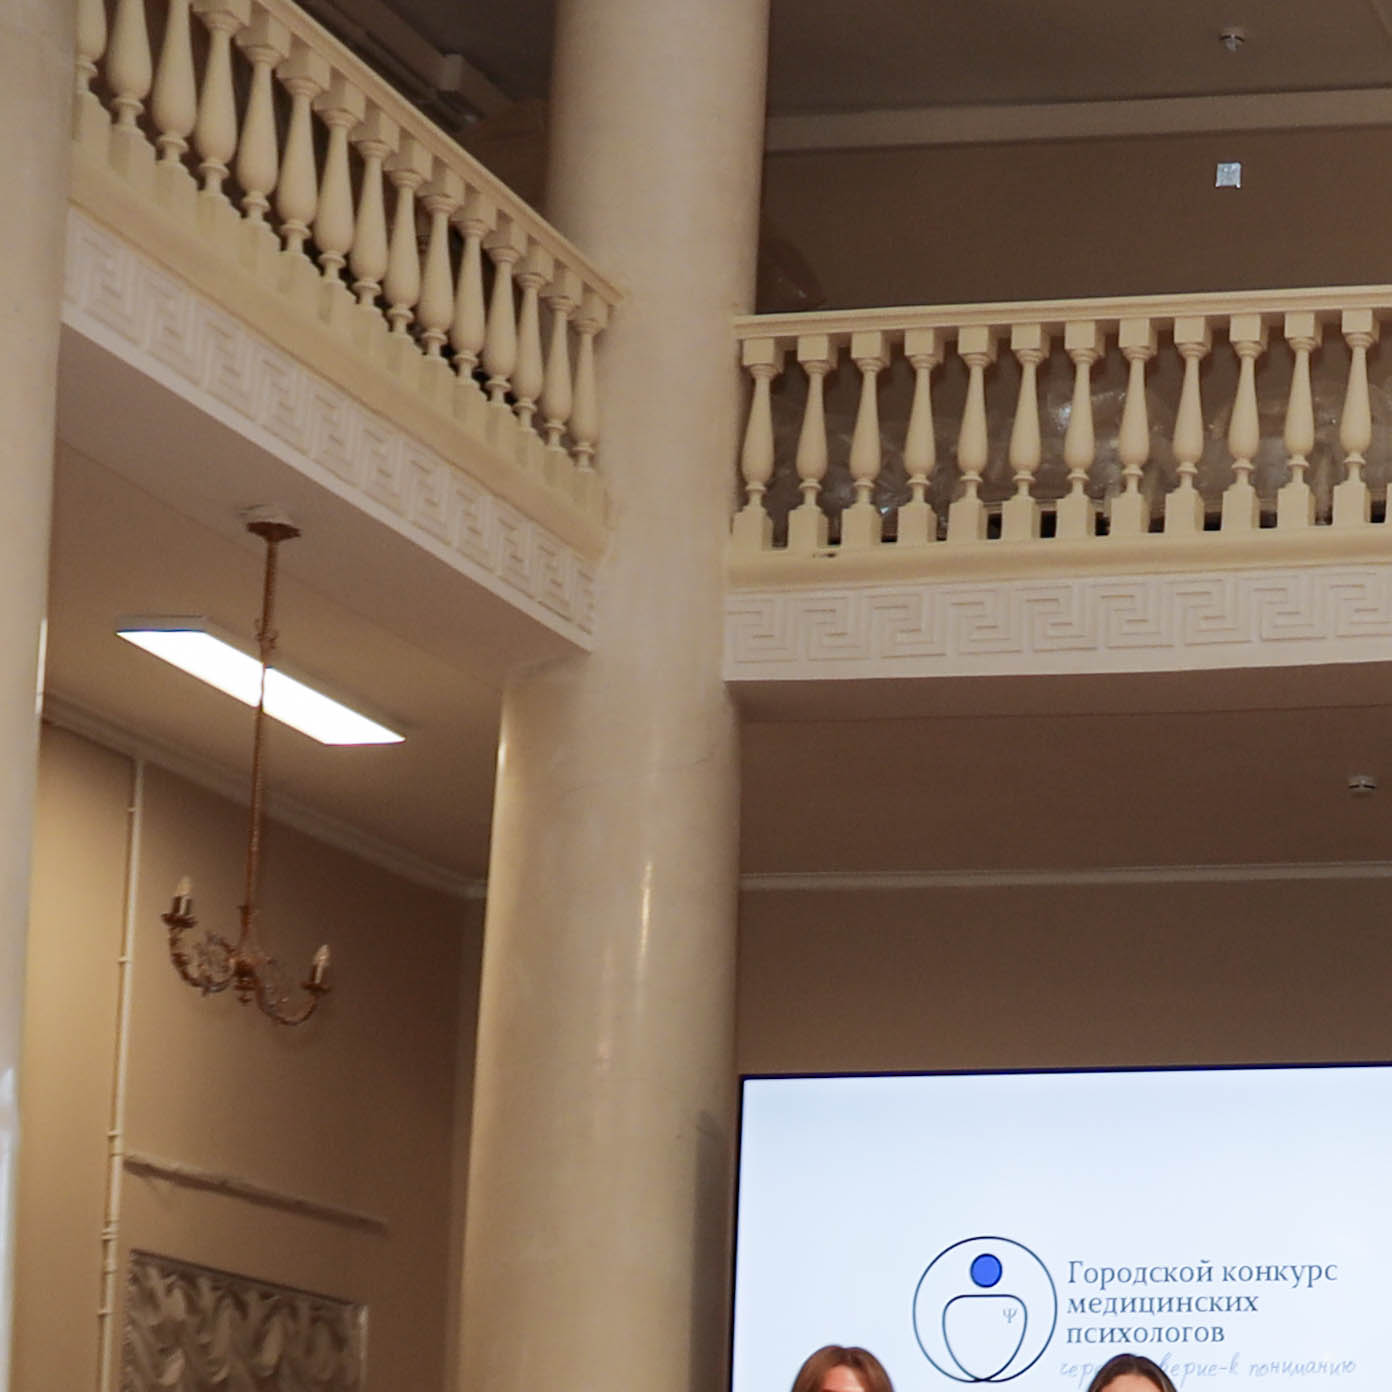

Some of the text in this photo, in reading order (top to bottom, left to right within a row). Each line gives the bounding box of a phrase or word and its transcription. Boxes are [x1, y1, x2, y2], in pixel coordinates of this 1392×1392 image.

[1067, 1258, 1339, 1291] Городской конкурс
[1066, 1295, 1259, 1317] медицинских
[1066, 1326, 1226, 1344] психологов
